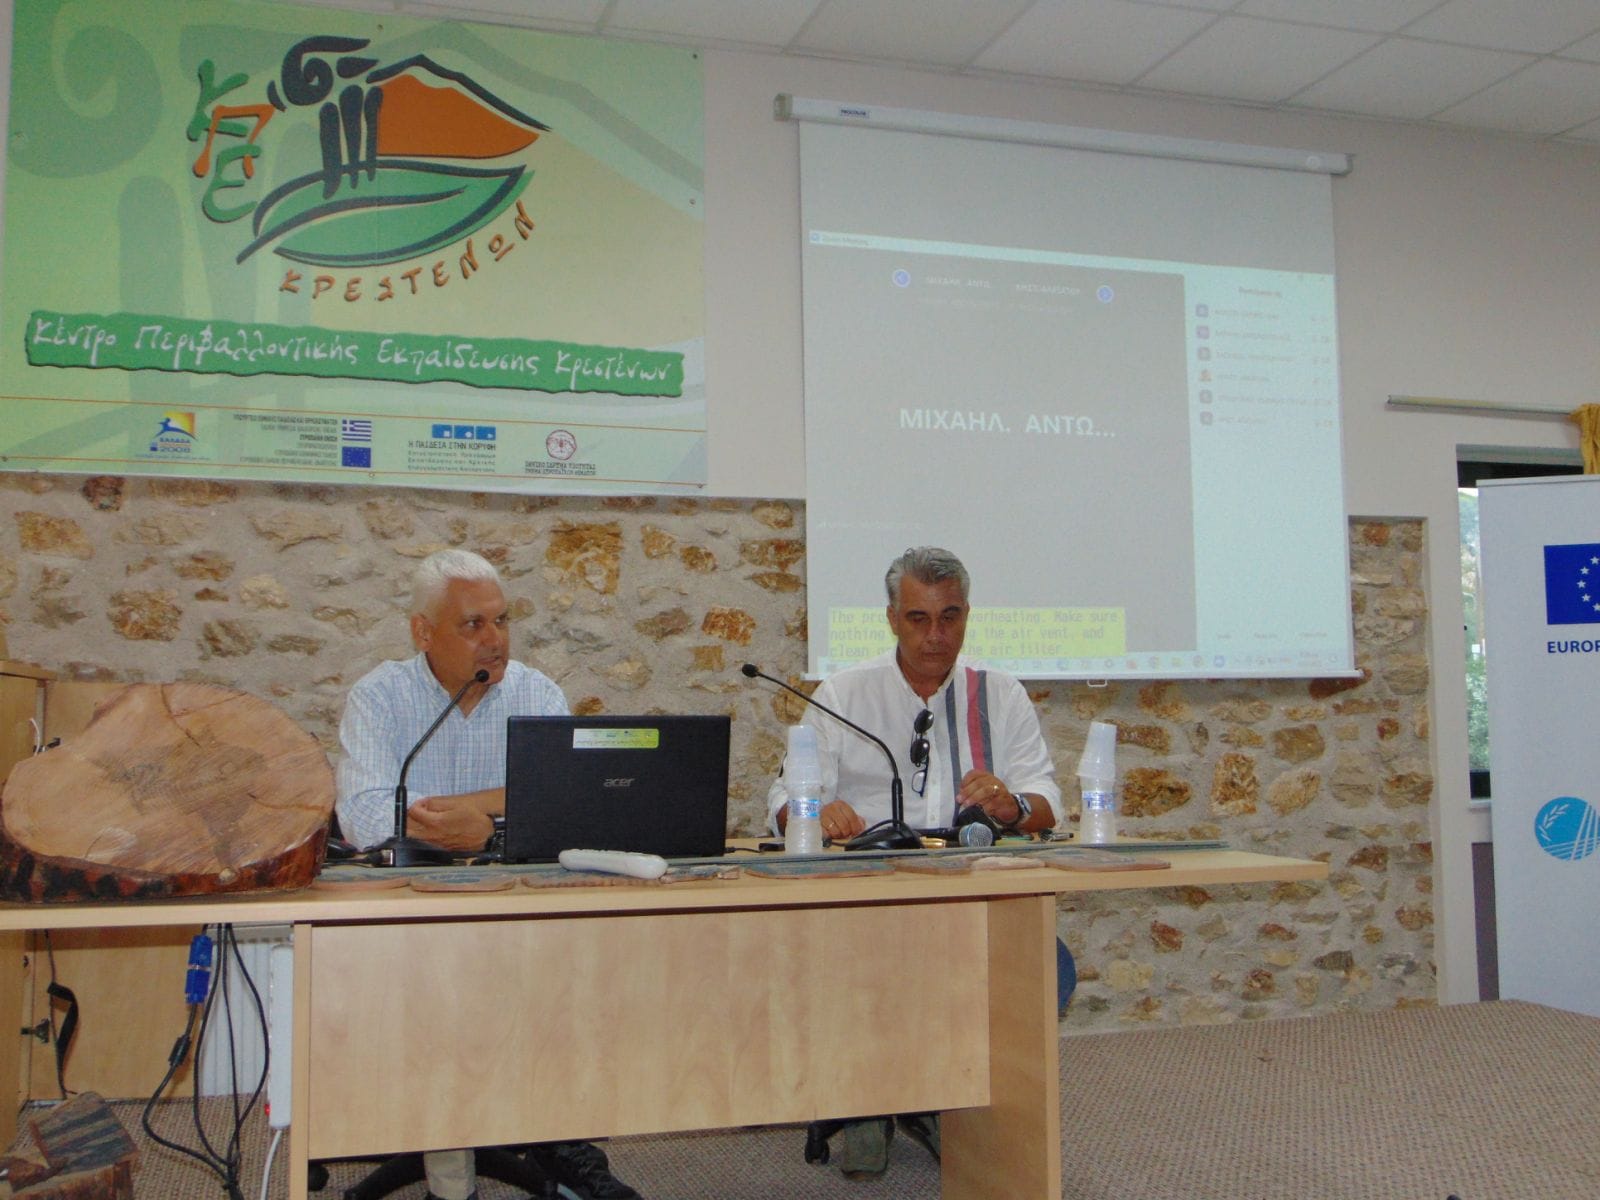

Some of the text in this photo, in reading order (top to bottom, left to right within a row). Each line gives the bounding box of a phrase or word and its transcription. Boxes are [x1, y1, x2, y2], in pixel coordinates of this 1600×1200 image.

[32, 316, 672, 390] Κέντρο Περιβαλλοντικής Εκπαίδευσης Κρεστένων
[969, 611, 1046, 624] verheating.
[1089, 613, 1118, 623] sure
[603, 778, 635, 788] acer
